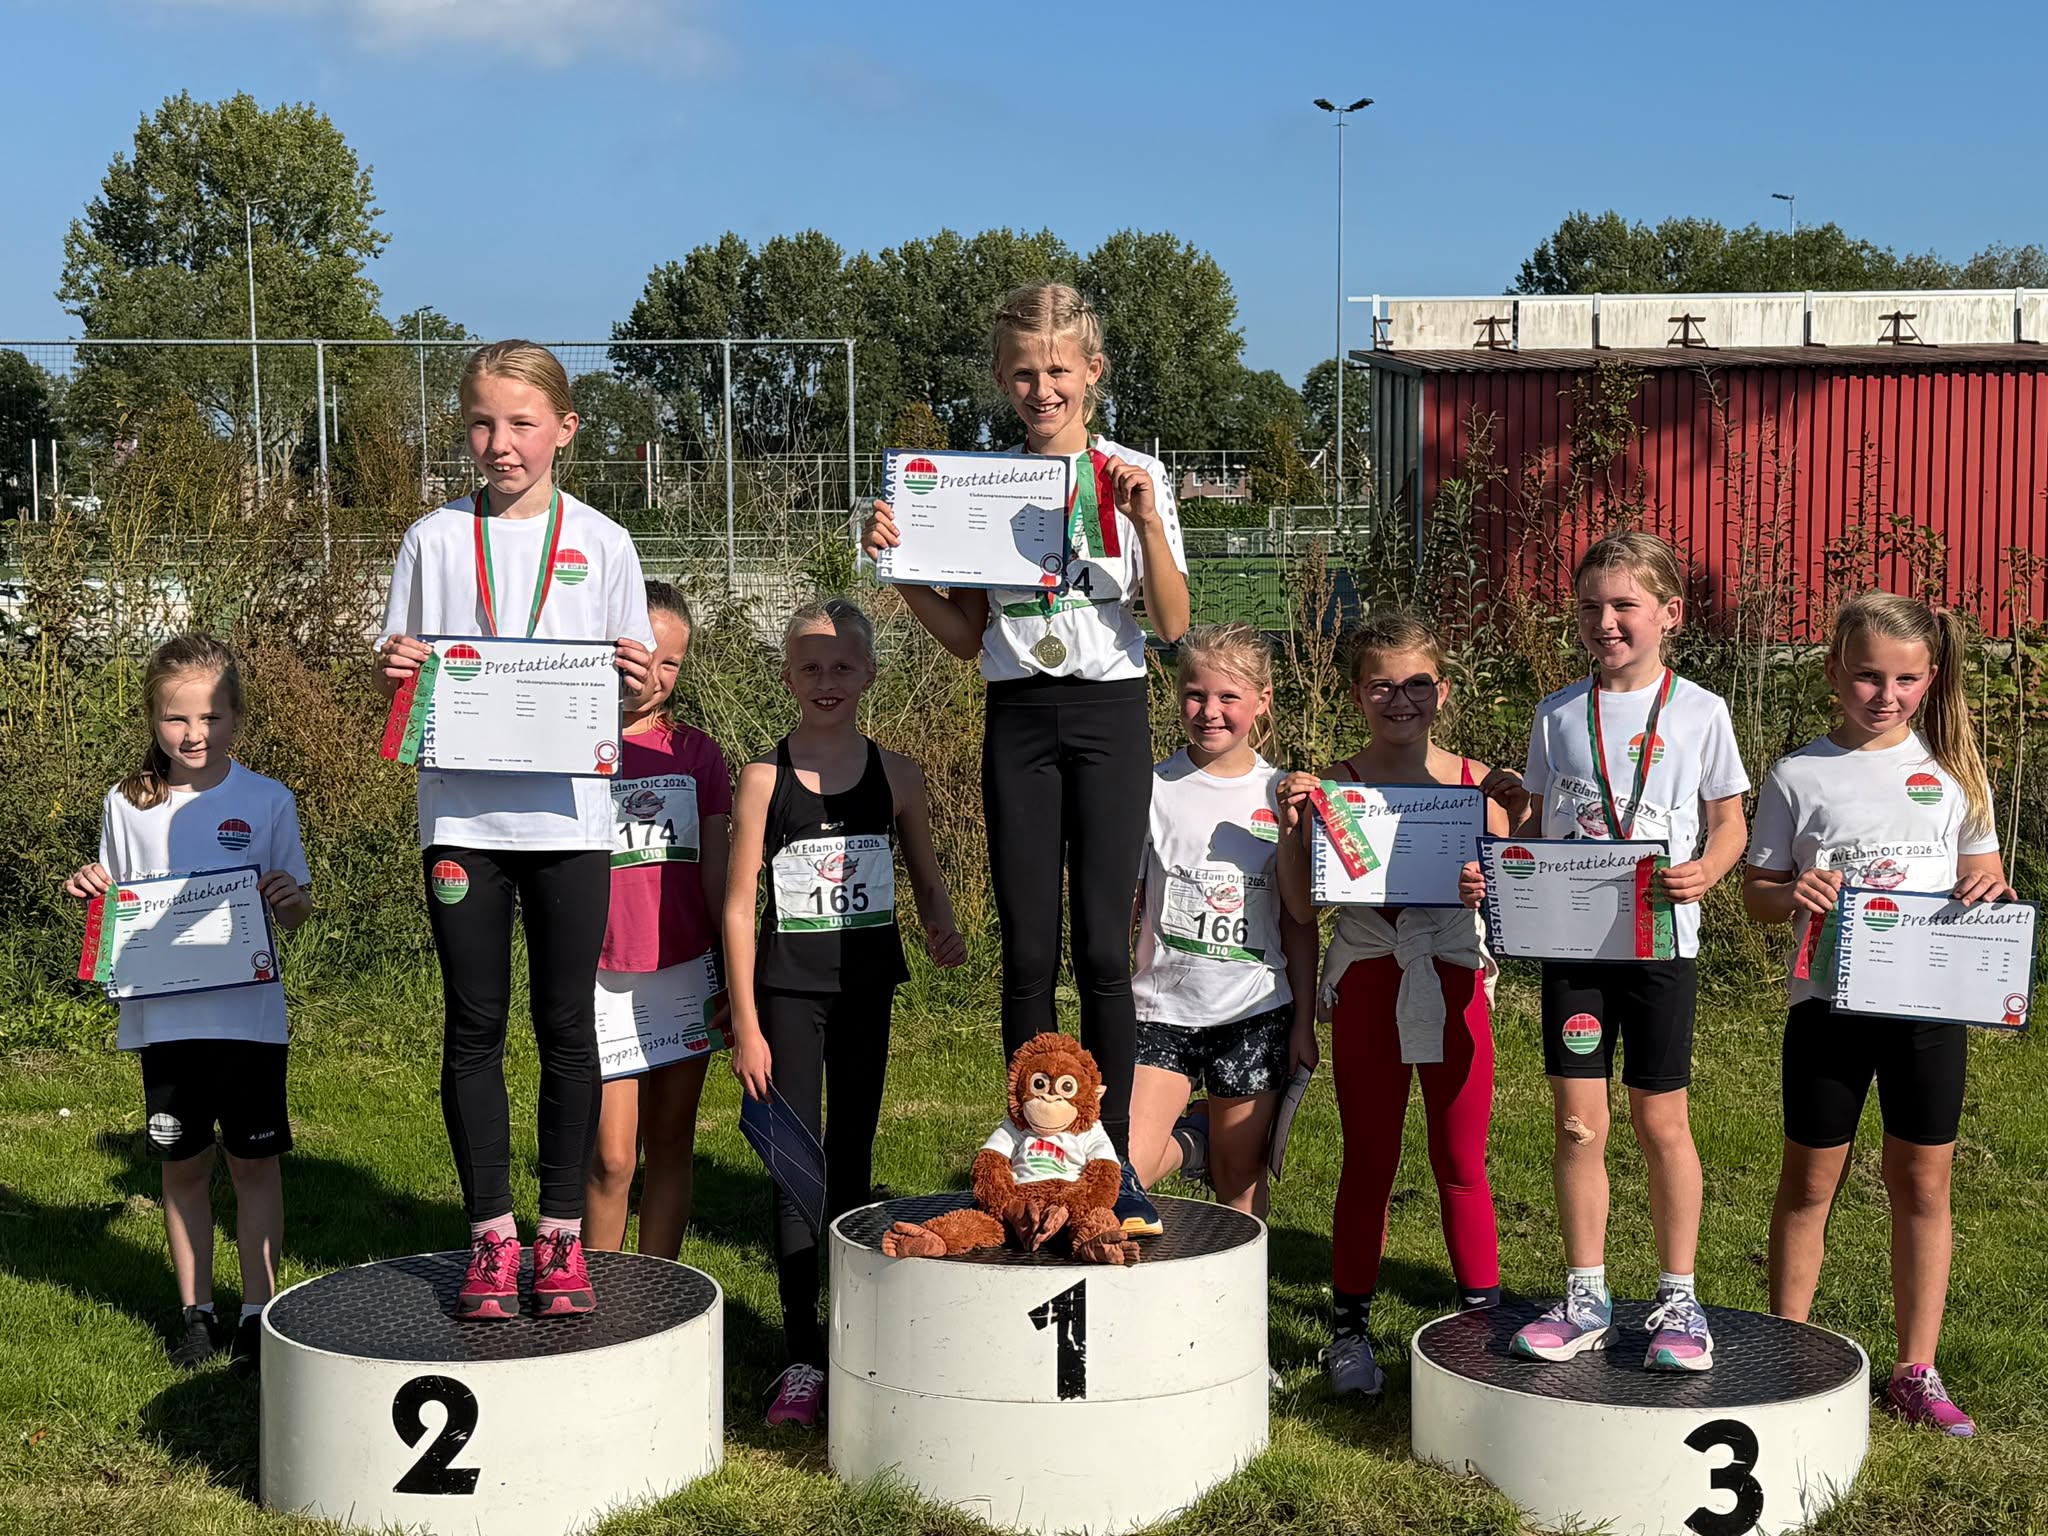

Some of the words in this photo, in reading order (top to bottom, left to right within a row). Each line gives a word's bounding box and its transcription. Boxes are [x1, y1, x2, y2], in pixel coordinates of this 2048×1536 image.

[940, 467, 1062, 489] Prestatiekaart!
[880, 453, 898, 578] PREKAART
[485, 651, 615, 675] Prestatiekaart!
[640, 780, 662, 788] OJC
[663, 778, 687, 787] 2026
[1560, 778, 1572, 790] AV
[1572, 783, 1600, 800] Edam
[1368, 795, 1479, 818] Prestatiekaart!
[619, 818, 678, 849] 174
[785, 844, 800, 855] AV
[802, 843, 833, 853] Edam
[857, 839, 880, 849] 2026
[640, 850, 662, 860] U10
[1845, 848, 1878, 861] Edam
[1881, 845, 1903, 856] OJC
[1906, 844, 1932, 855] 2026
[1194, 871, 1225, 882] Edam
[144, 875, 254, 914] Prestatiekaart!
[809, 883, 869, 915] 165
[1482, 840, 1505, 955] PRESTATIEKAART
[1193, 911, 1249, 945] 166
[1901, 909, 2029, 928] Prestatiekaart!
[1206, 944, 1228, 956] U10
[1836, 891, 1858, 1009] PRESTATIEKAART
[599, 1032, 679, 1067] Prestatieka
[1027, 1278, 1086, 1401] 1
[391, 1375, 481, 1495] 2
[1684, 1419, 1764, 1536] 3
